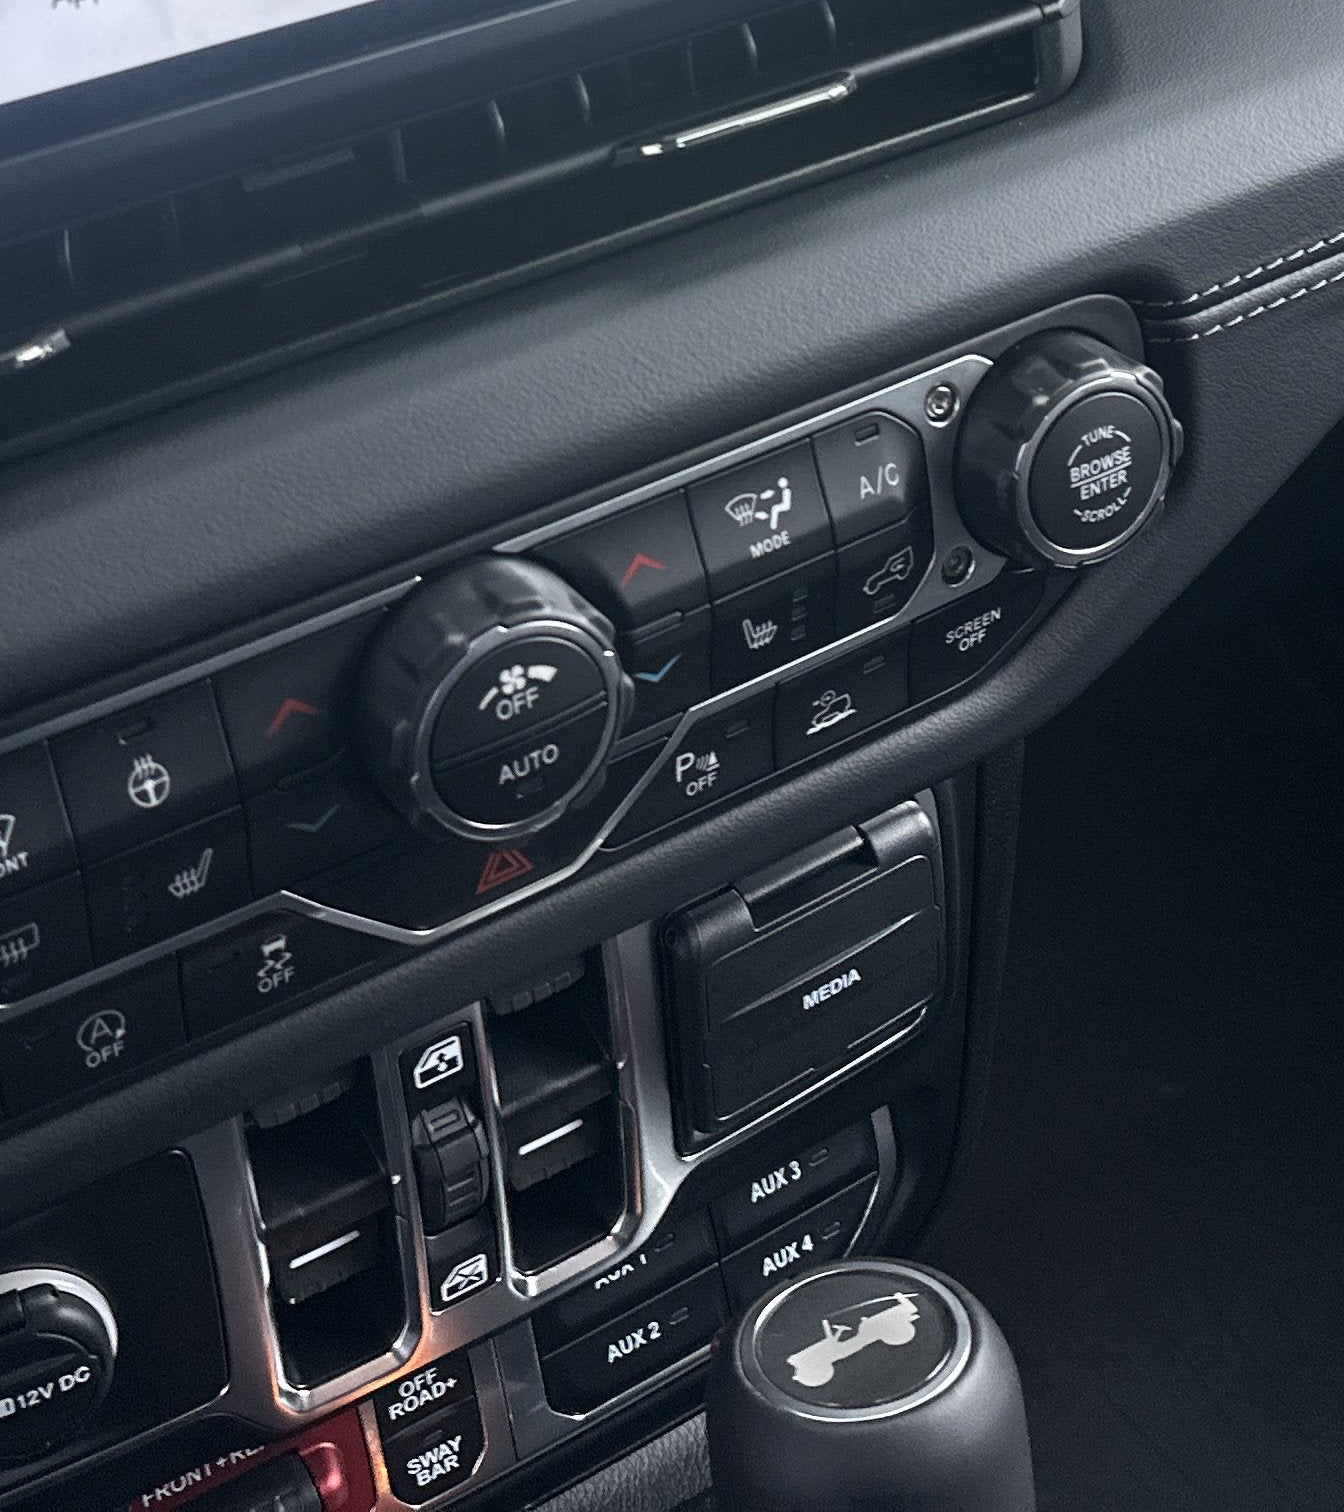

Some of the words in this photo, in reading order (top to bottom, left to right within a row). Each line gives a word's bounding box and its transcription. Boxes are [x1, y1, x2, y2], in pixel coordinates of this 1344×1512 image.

[1081, 425, 1115, 447] TUNE
[860, 462, 900, 500] A/C
[1069, 445, 1132, 483] BROWSE
[1080, 470, 1128, 501] ENTER
[1081, 497, 1128, 523] SCROLL
[748, 529, 792, 560] MODE
[945, 607, 1001, 644] SCREEN
[958, 628, 987, 652] OFF
[496, 687, 540, 721] OFF
[498, 743, 560, 786] AUTO
[686, 771, 718, 797] OFF
[257, 966, 296, 993] OFF
[802, 968, 862, 1010] MEDIA
[85, 1039, 125, 1068] OFF
[750, 1167, 789, 1203] AUX
[787, 1159, 803, 1181] 3
[763, 1241, 802, 1277] AUX
[802, 1234, 815, 1251] 4
[609, 1328, 648, 1364] AUX
[648, 1321, 664, 1339] 2
[17, 1382, 55, 1409] 12V
[58, 1366, 91, 1392] DC
[388, 1377, 457, 1421] ROAD+
[398, 1366, 438, 1399] OFF
[406, 1435, 462, 1475] SWAY
[415, 1454, 460, 1488] BAR
